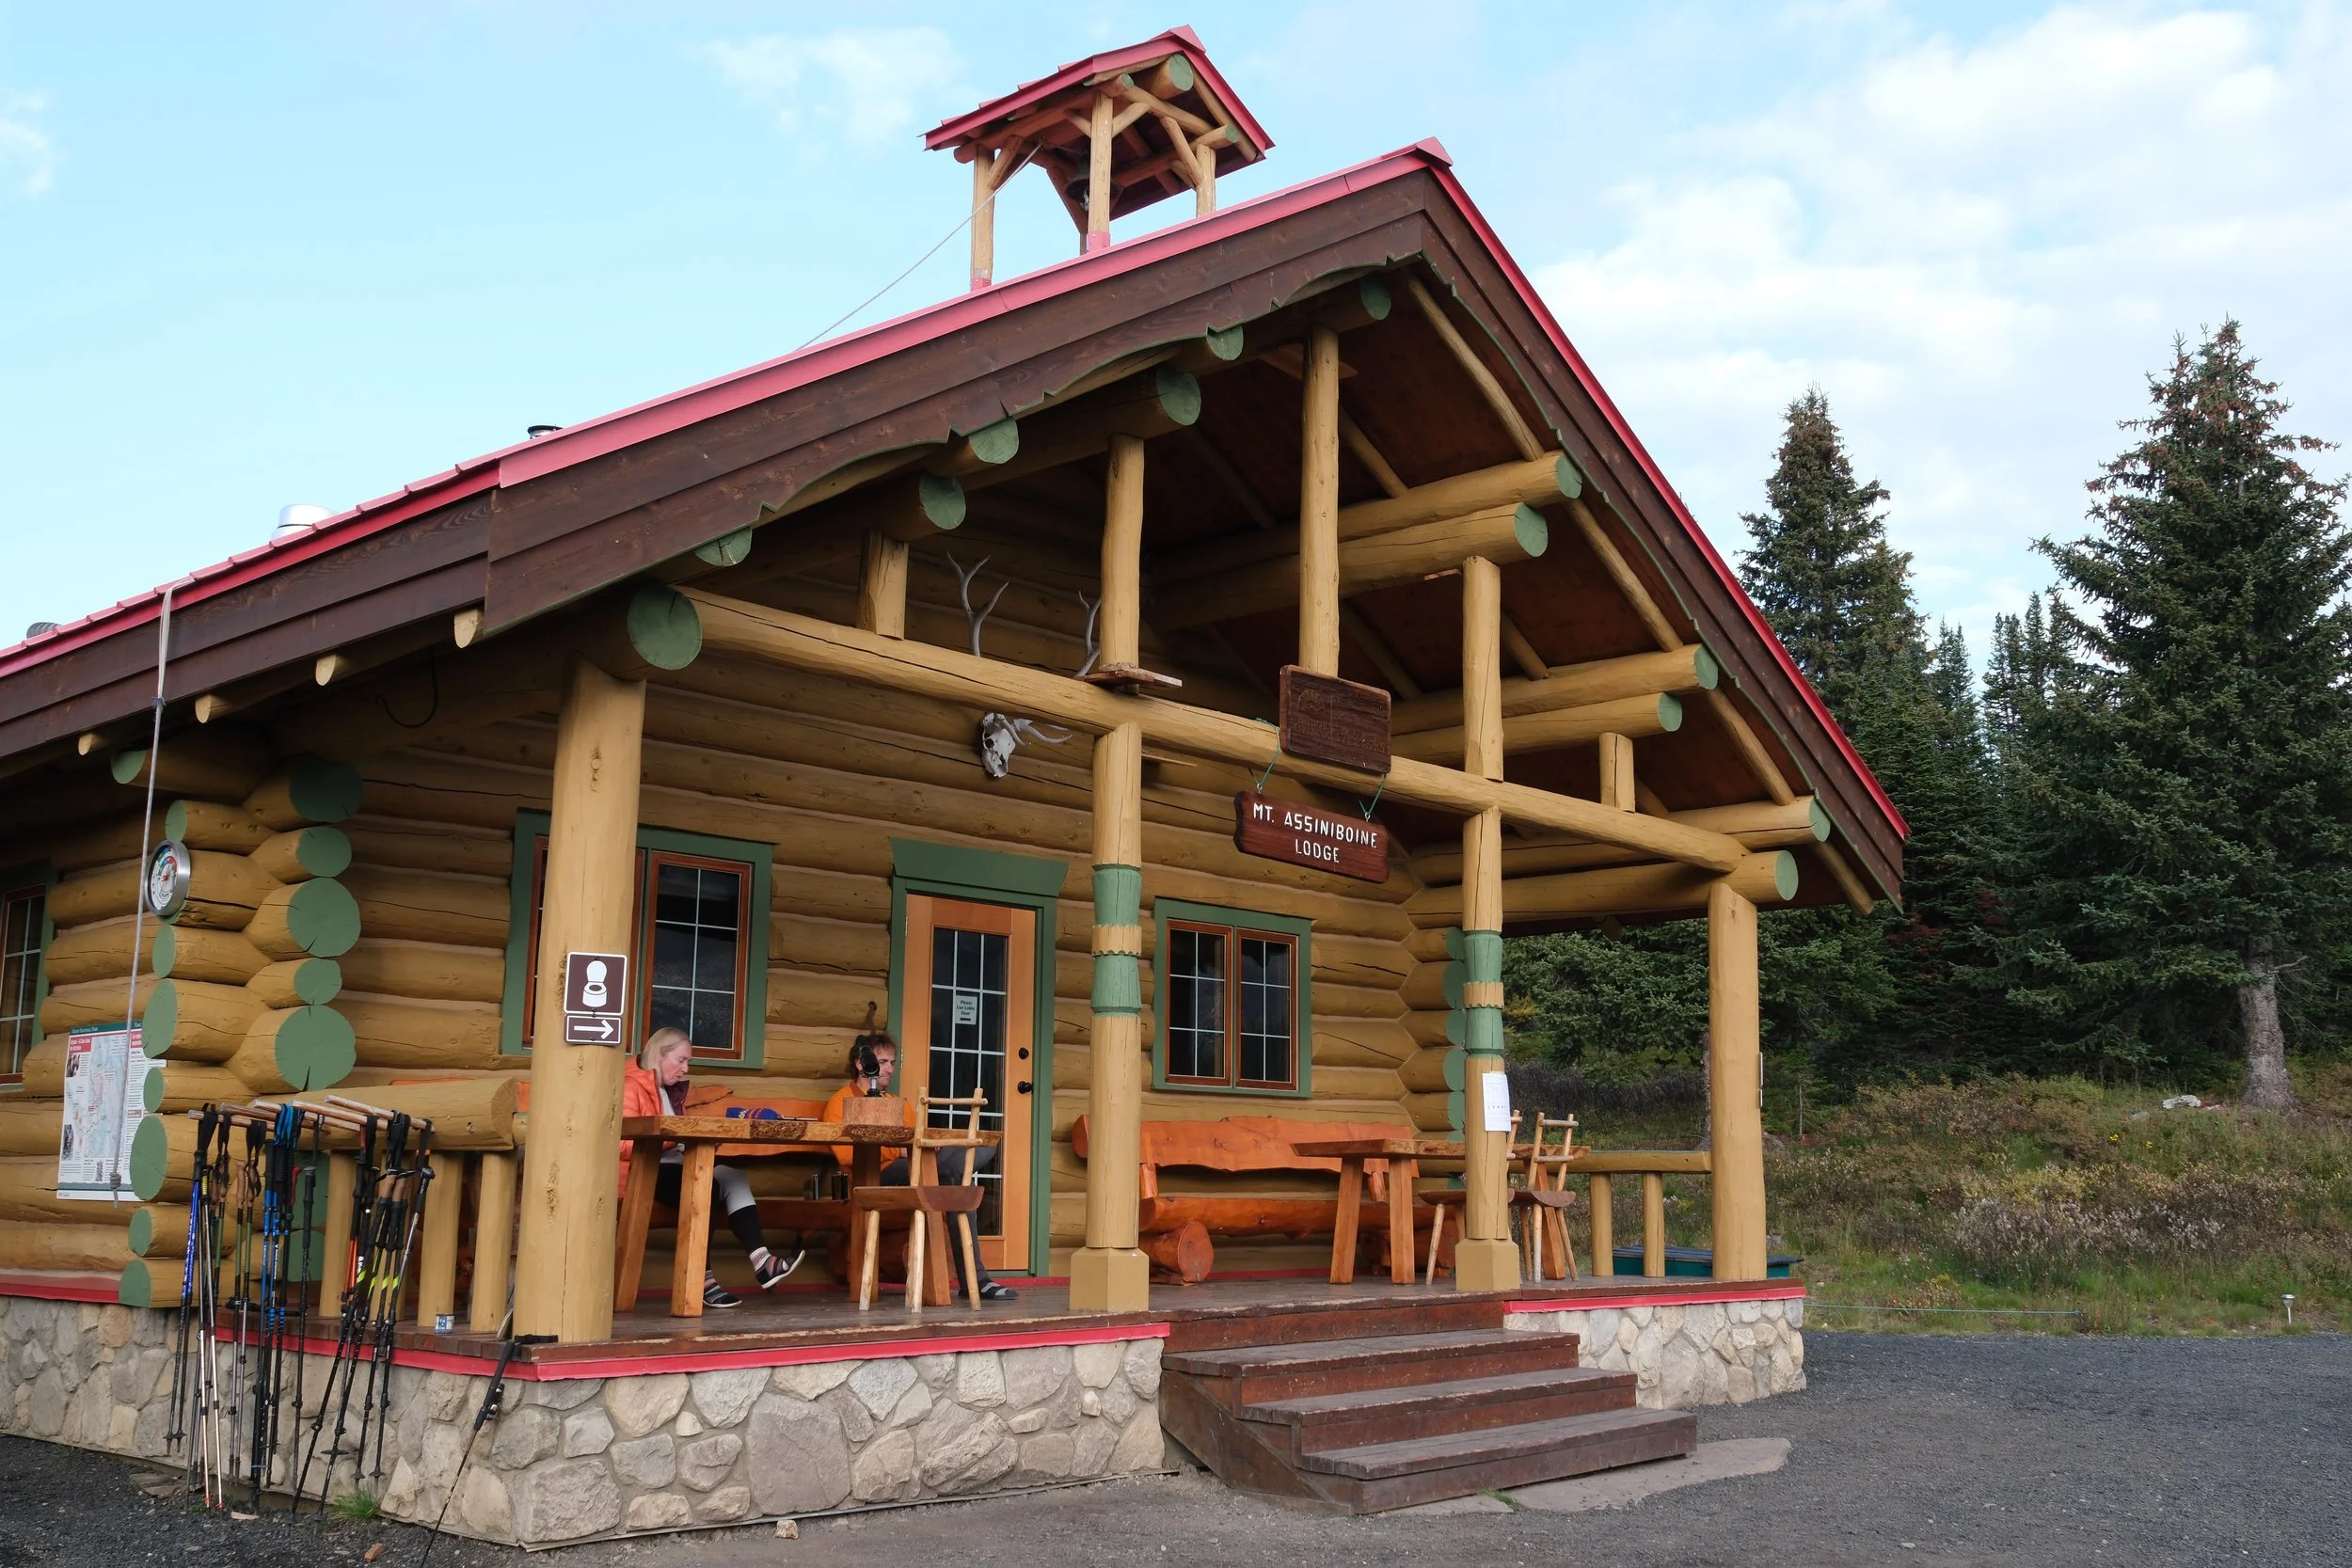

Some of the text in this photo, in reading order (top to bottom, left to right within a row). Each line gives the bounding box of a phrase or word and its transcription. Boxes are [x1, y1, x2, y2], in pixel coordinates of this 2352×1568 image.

[1253, 802, 1378, 848] MT. ASSINIBOINE
[1295, 838, 1340, 863] LODGE
